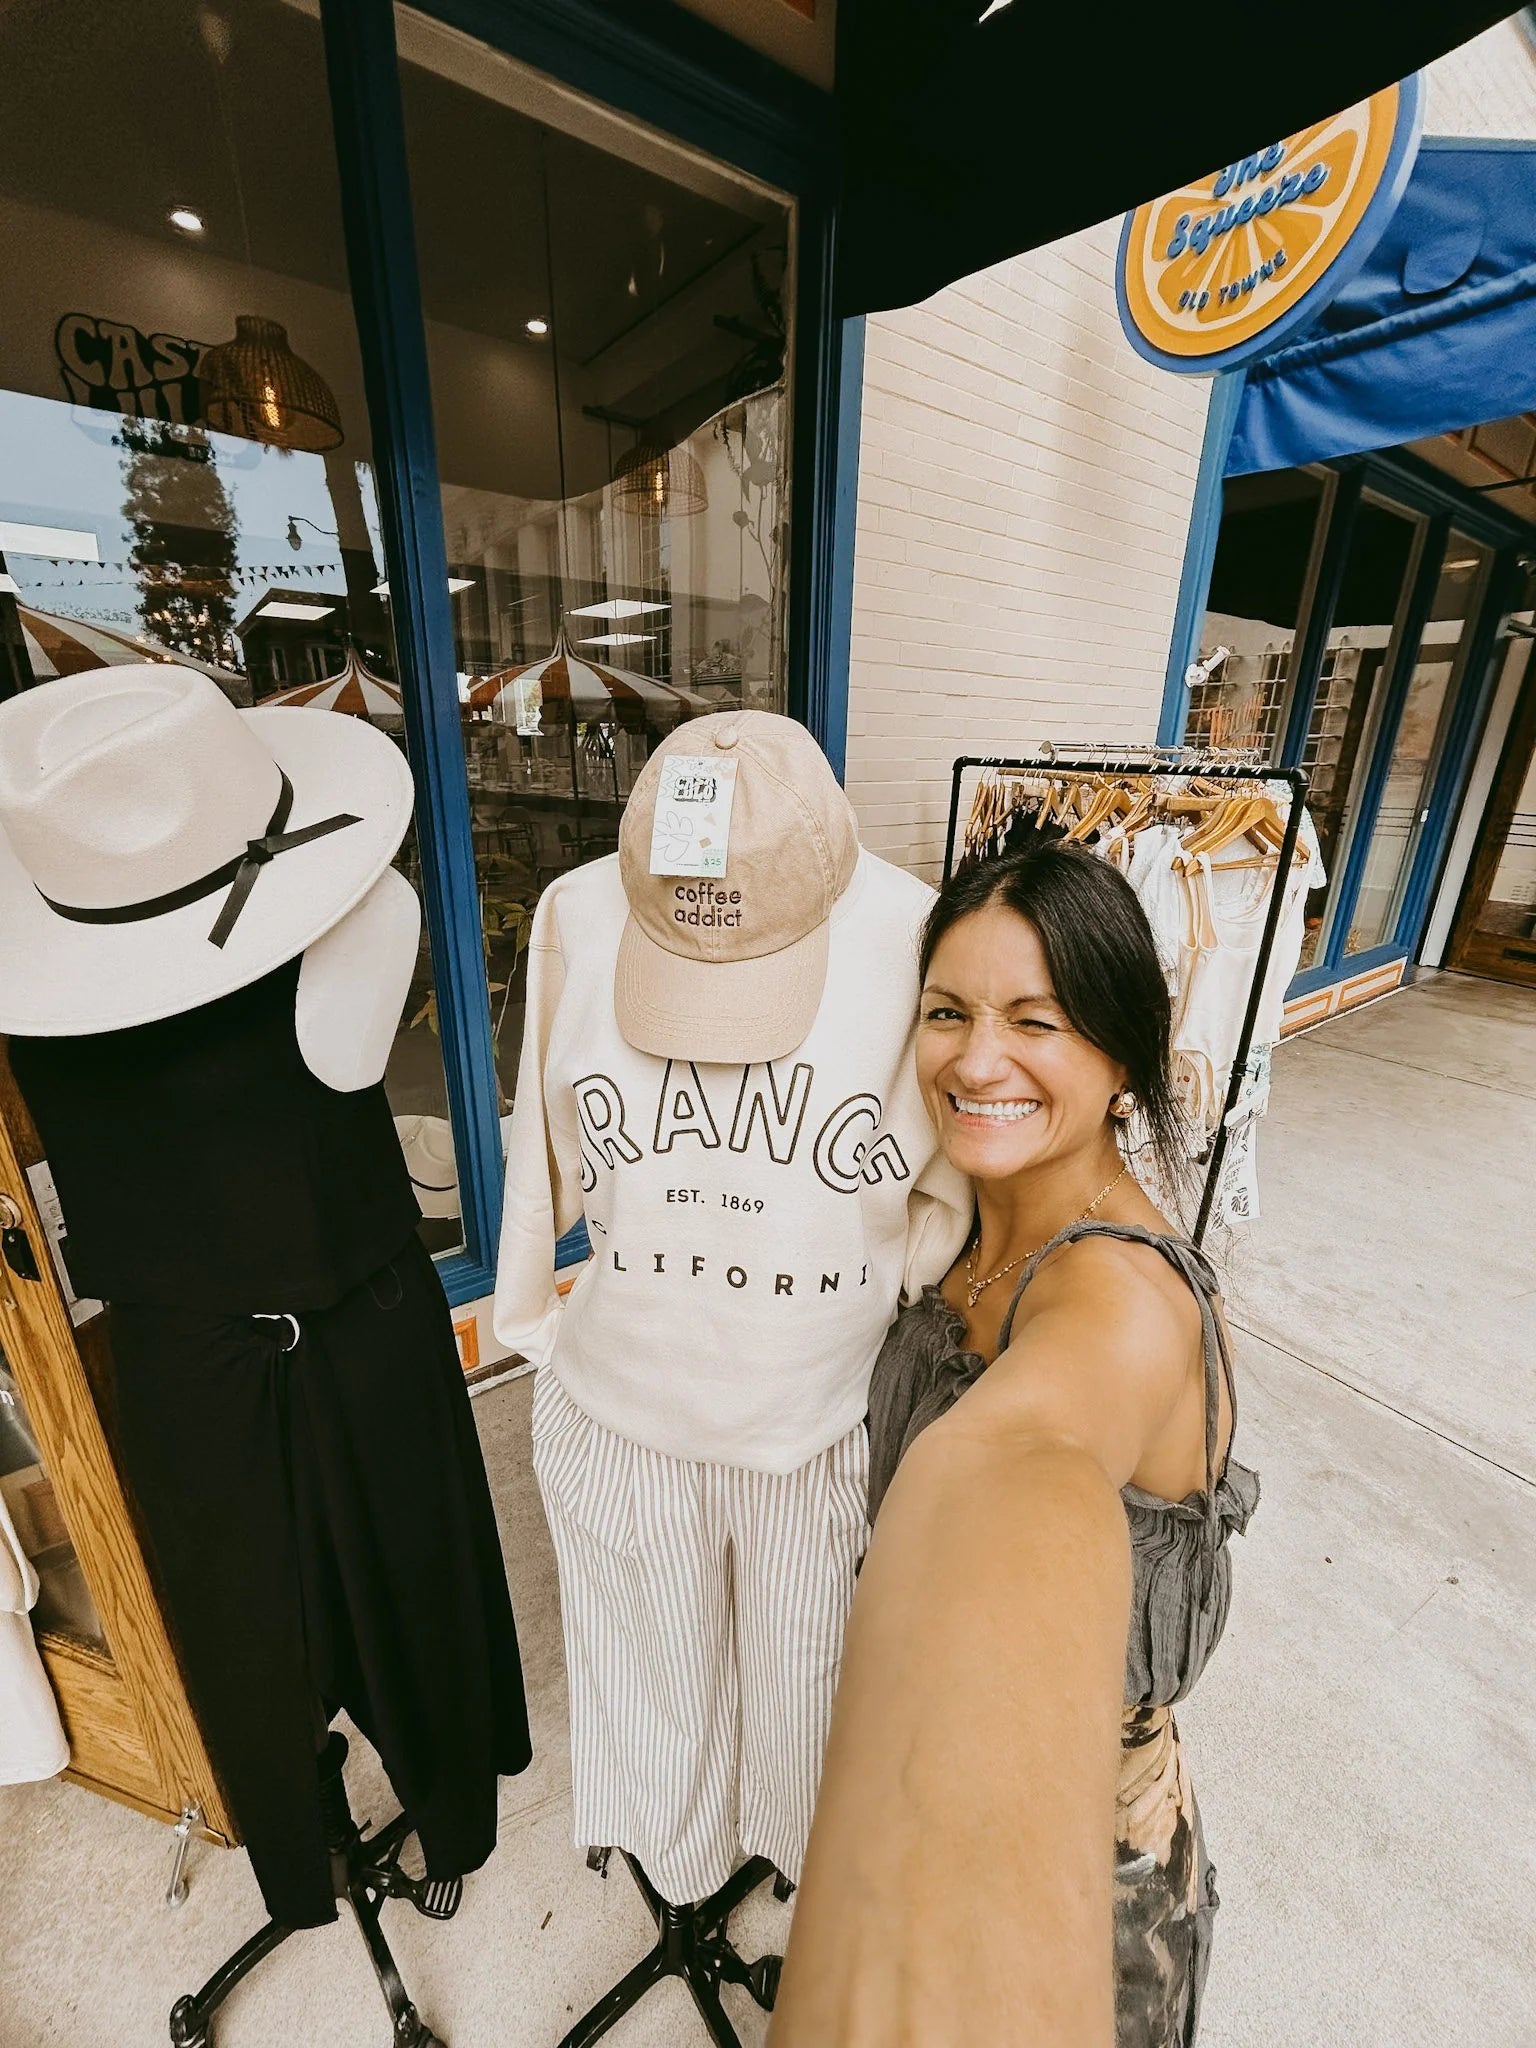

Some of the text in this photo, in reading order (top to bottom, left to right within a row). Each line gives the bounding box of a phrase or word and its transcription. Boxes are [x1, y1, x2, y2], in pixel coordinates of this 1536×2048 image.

[1167, 161, 1331, 259] Squeeze
[1179, 248, 1287, 311] OLD TOWNE
[54, 312, 215, 390] CAS
[675, 882, 742, 905] coffee
[674, 905, 742, 928] addict
[666, 1189, 765, 1214] EST. 1869
